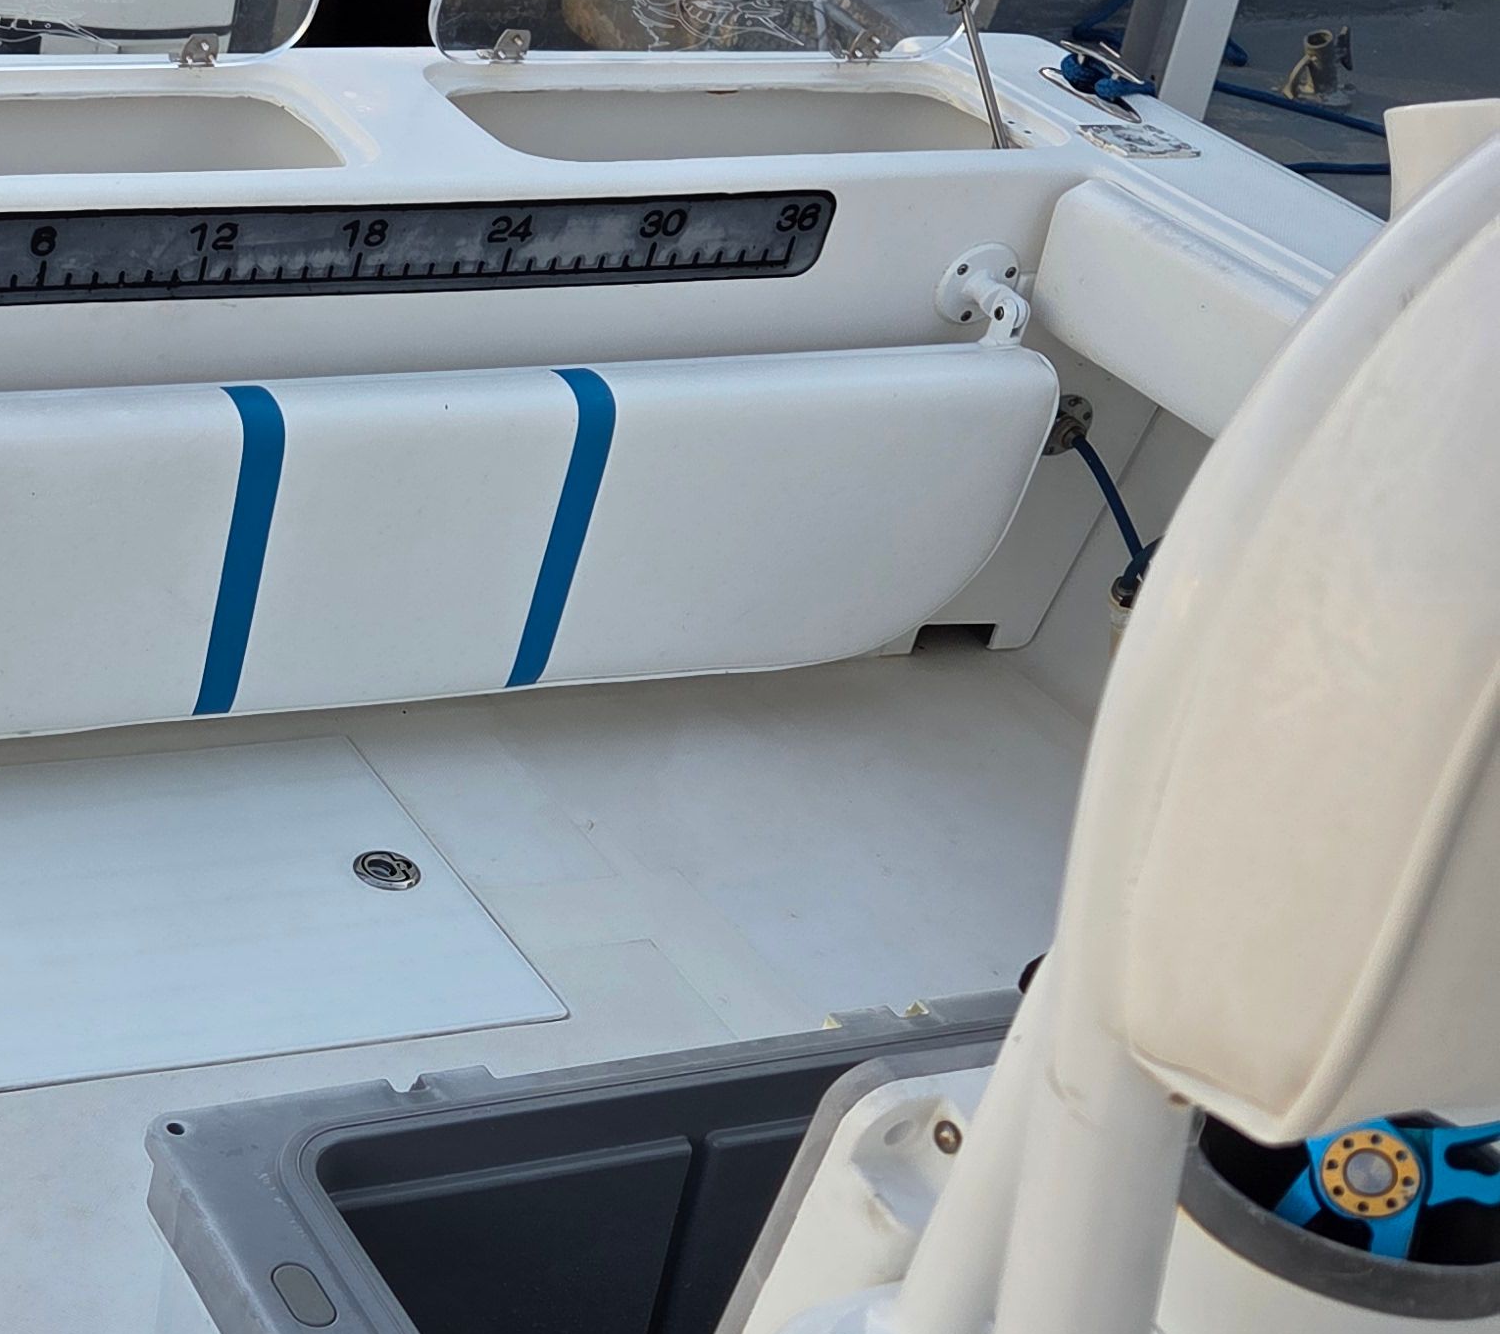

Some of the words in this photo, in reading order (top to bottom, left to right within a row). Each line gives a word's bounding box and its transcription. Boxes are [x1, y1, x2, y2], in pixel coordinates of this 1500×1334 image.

[30, 226, 57, 256] 6
[190, 222, 239, 252] 12
[342, 219, 388, 248] 18
[487, 214, 533, 244] 24
[638, 208, 687, 238] 30
[775, 202, 821, 232] 36
